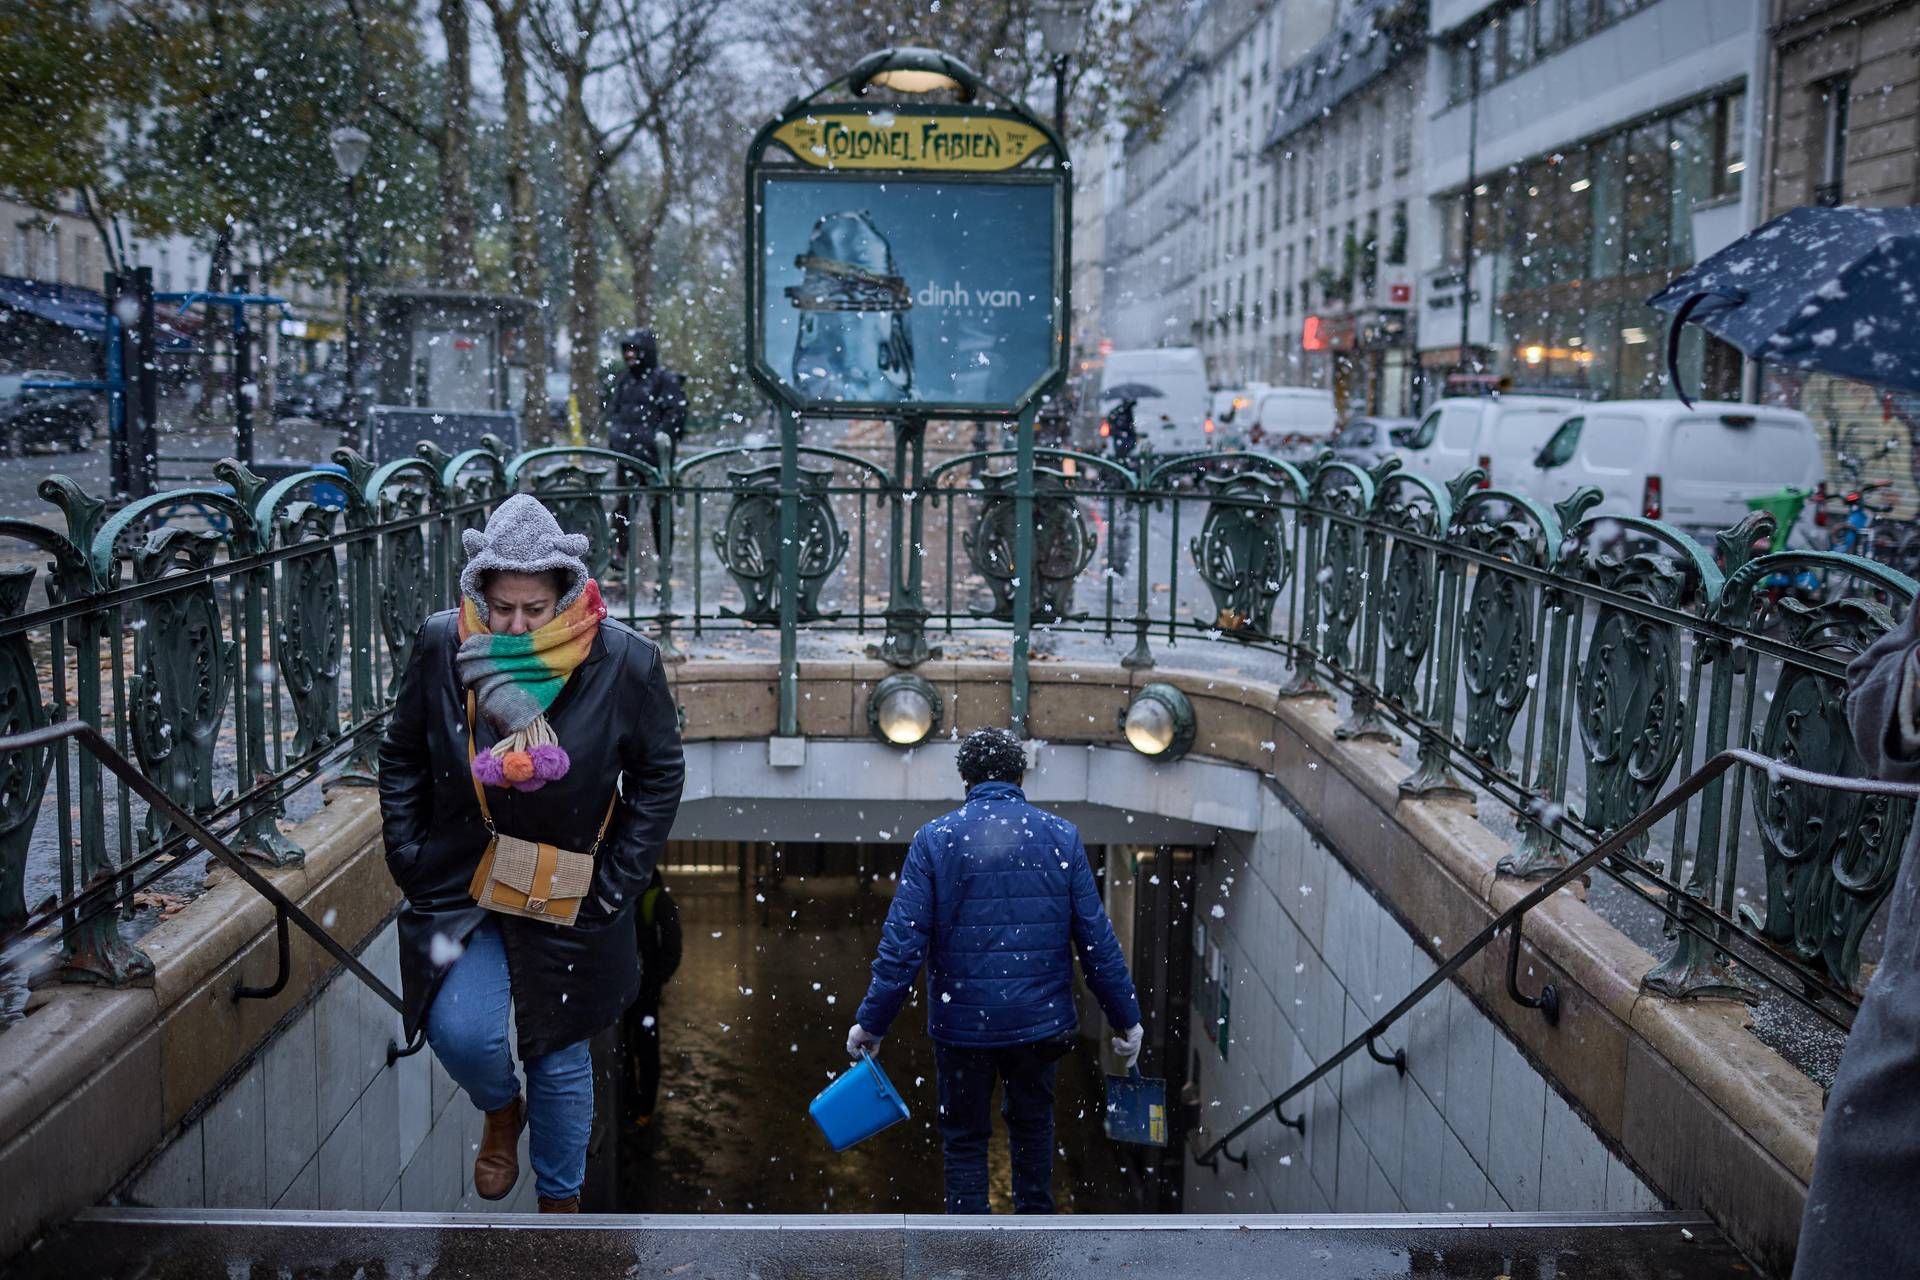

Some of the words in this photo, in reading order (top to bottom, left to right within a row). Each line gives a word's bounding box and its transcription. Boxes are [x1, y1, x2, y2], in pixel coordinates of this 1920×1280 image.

[824, 121, 917, 161] COLONEL
[922, 123, 1001, 162] FABIEN
[917, 280, 969, 307] dinh
[975, 289, 1021, 307] van
